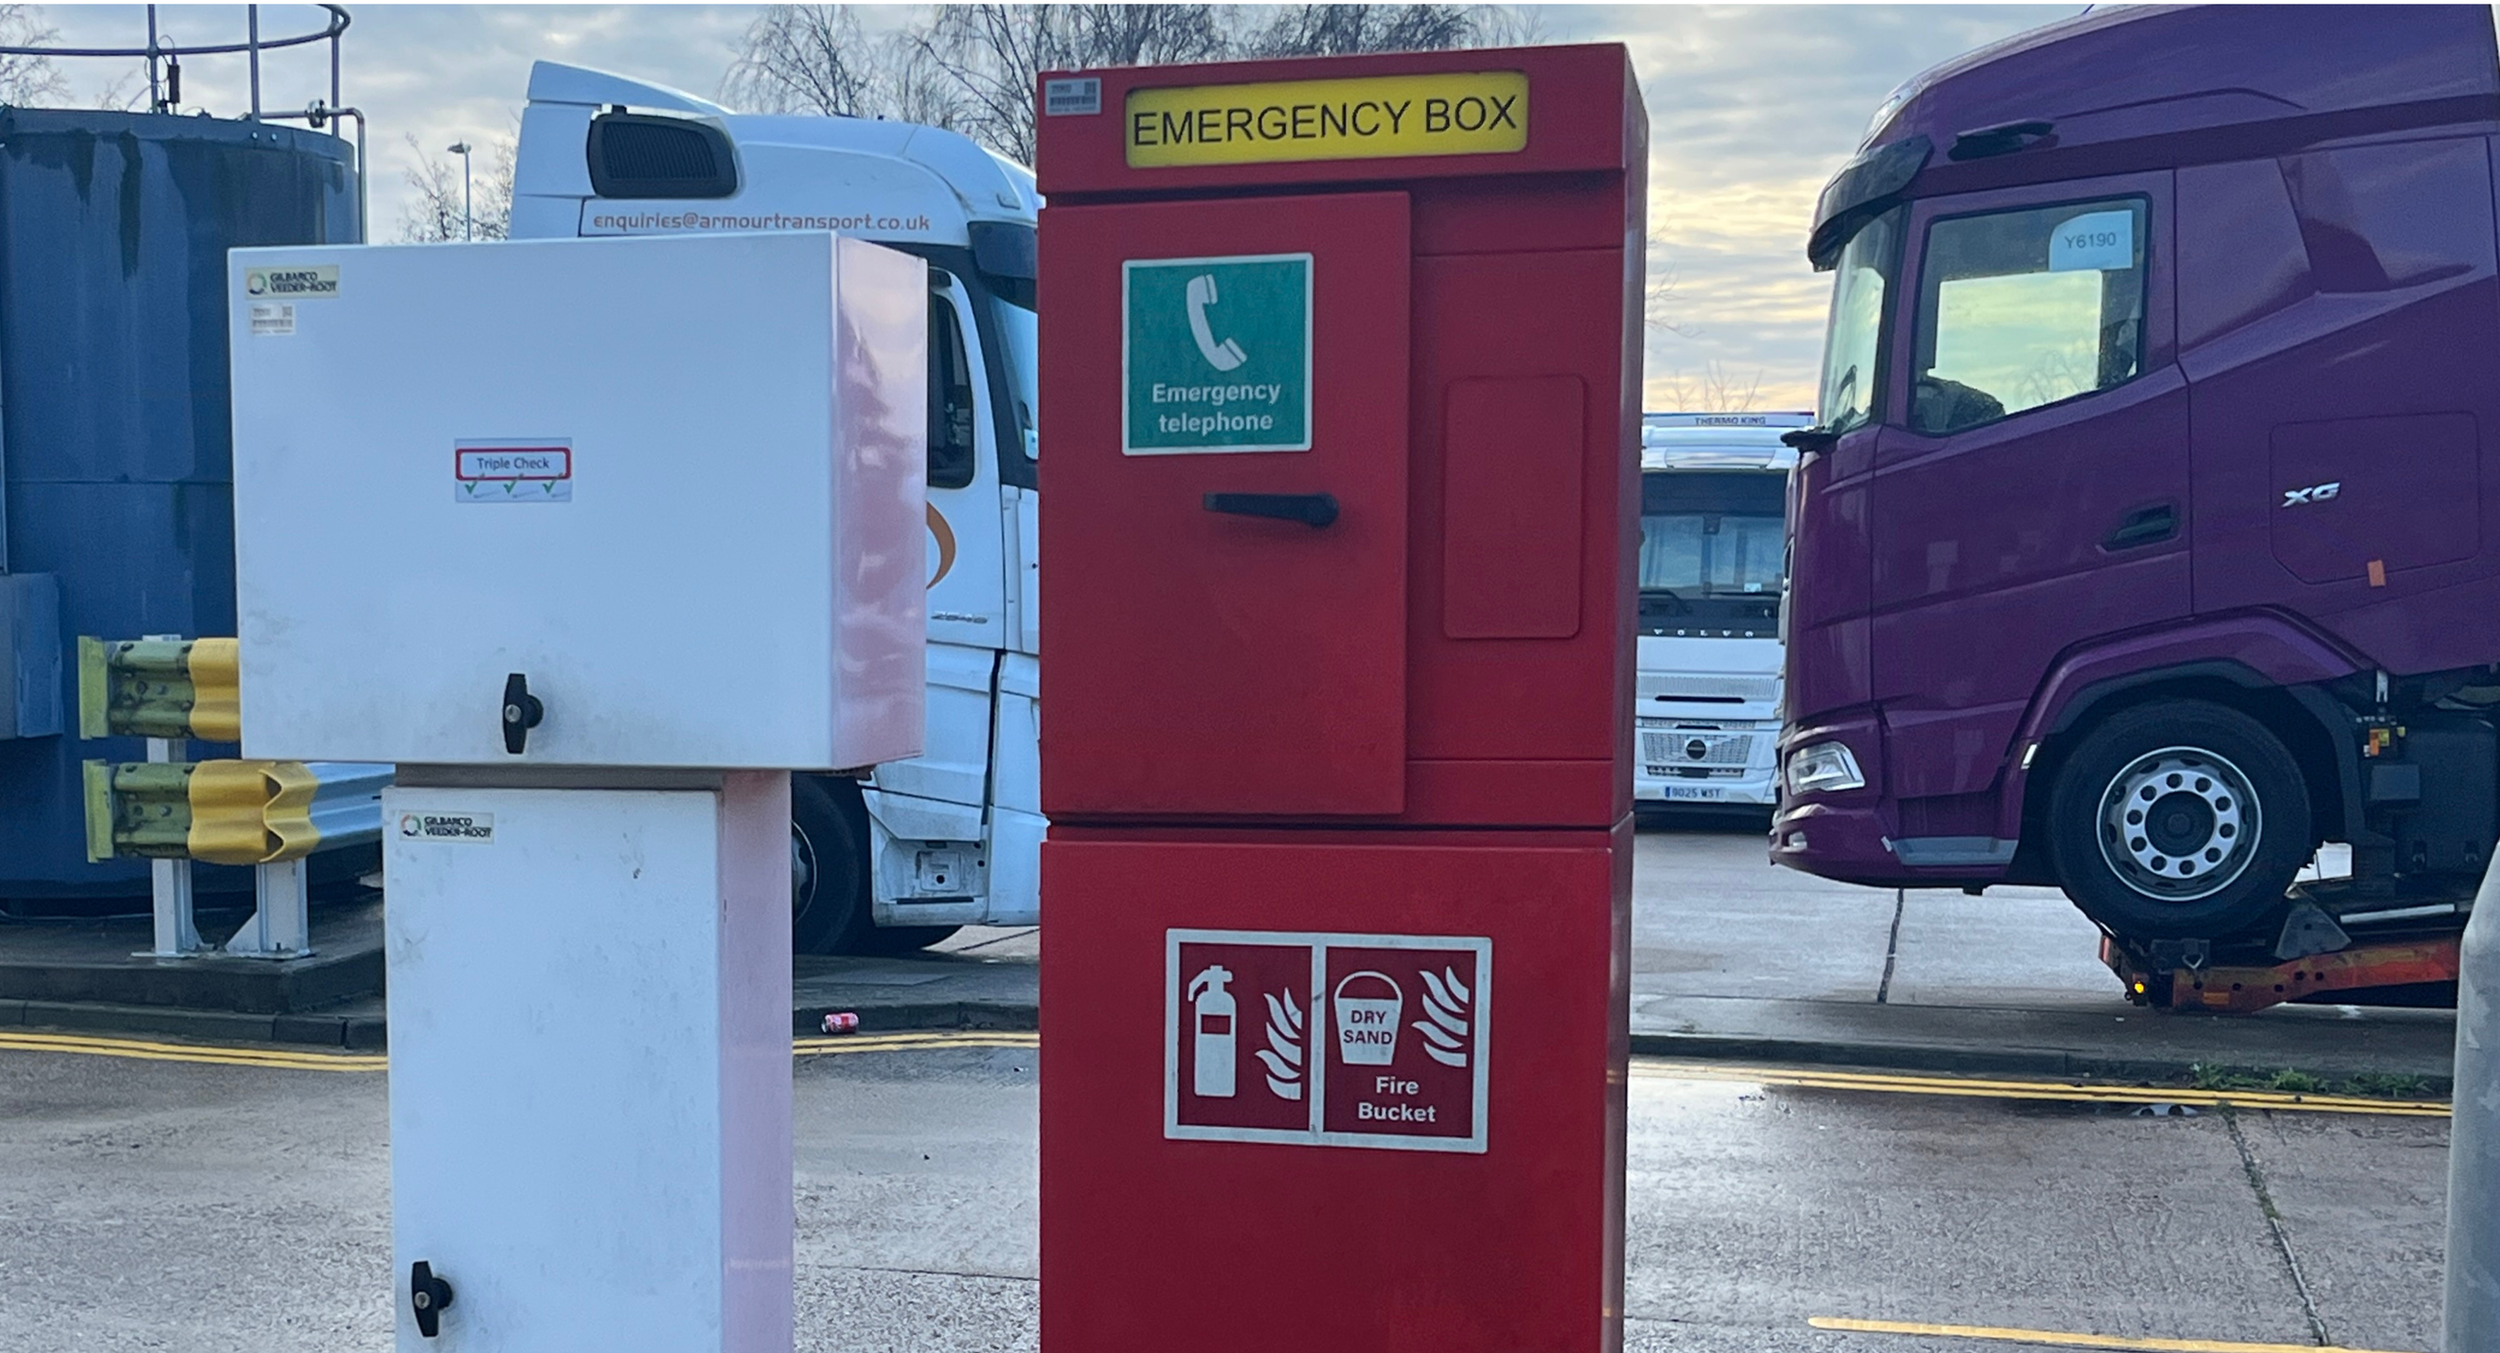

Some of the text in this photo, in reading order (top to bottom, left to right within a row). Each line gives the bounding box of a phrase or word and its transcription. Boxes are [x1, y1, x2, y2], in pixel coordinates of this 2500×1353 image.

[1133, 94, 1518, 147] EMERGENCY BOX
[593, 211, 931, 232] enquiries@armourtransport.co.uk
[2064, 231, 2117, 249] Y6190
[1152, 383, 1281, 406] Emergency
[1158, 411, 1273, 436] telephone
[1695, 416, 1766, 425] THERMO KING
[476, 457, 550, 471] Triple Check
[2282, 482, 2340, 508] XG
[1653, 628, 1755, 638] VOLVO
[1351, 1010, 1387, 1024] DRY
[1343, 1029, 1393, 1045] SAND
[1376, 1076, 1419, 1095] Fire
[1358, 1102, 1436, 1123] Bucket
